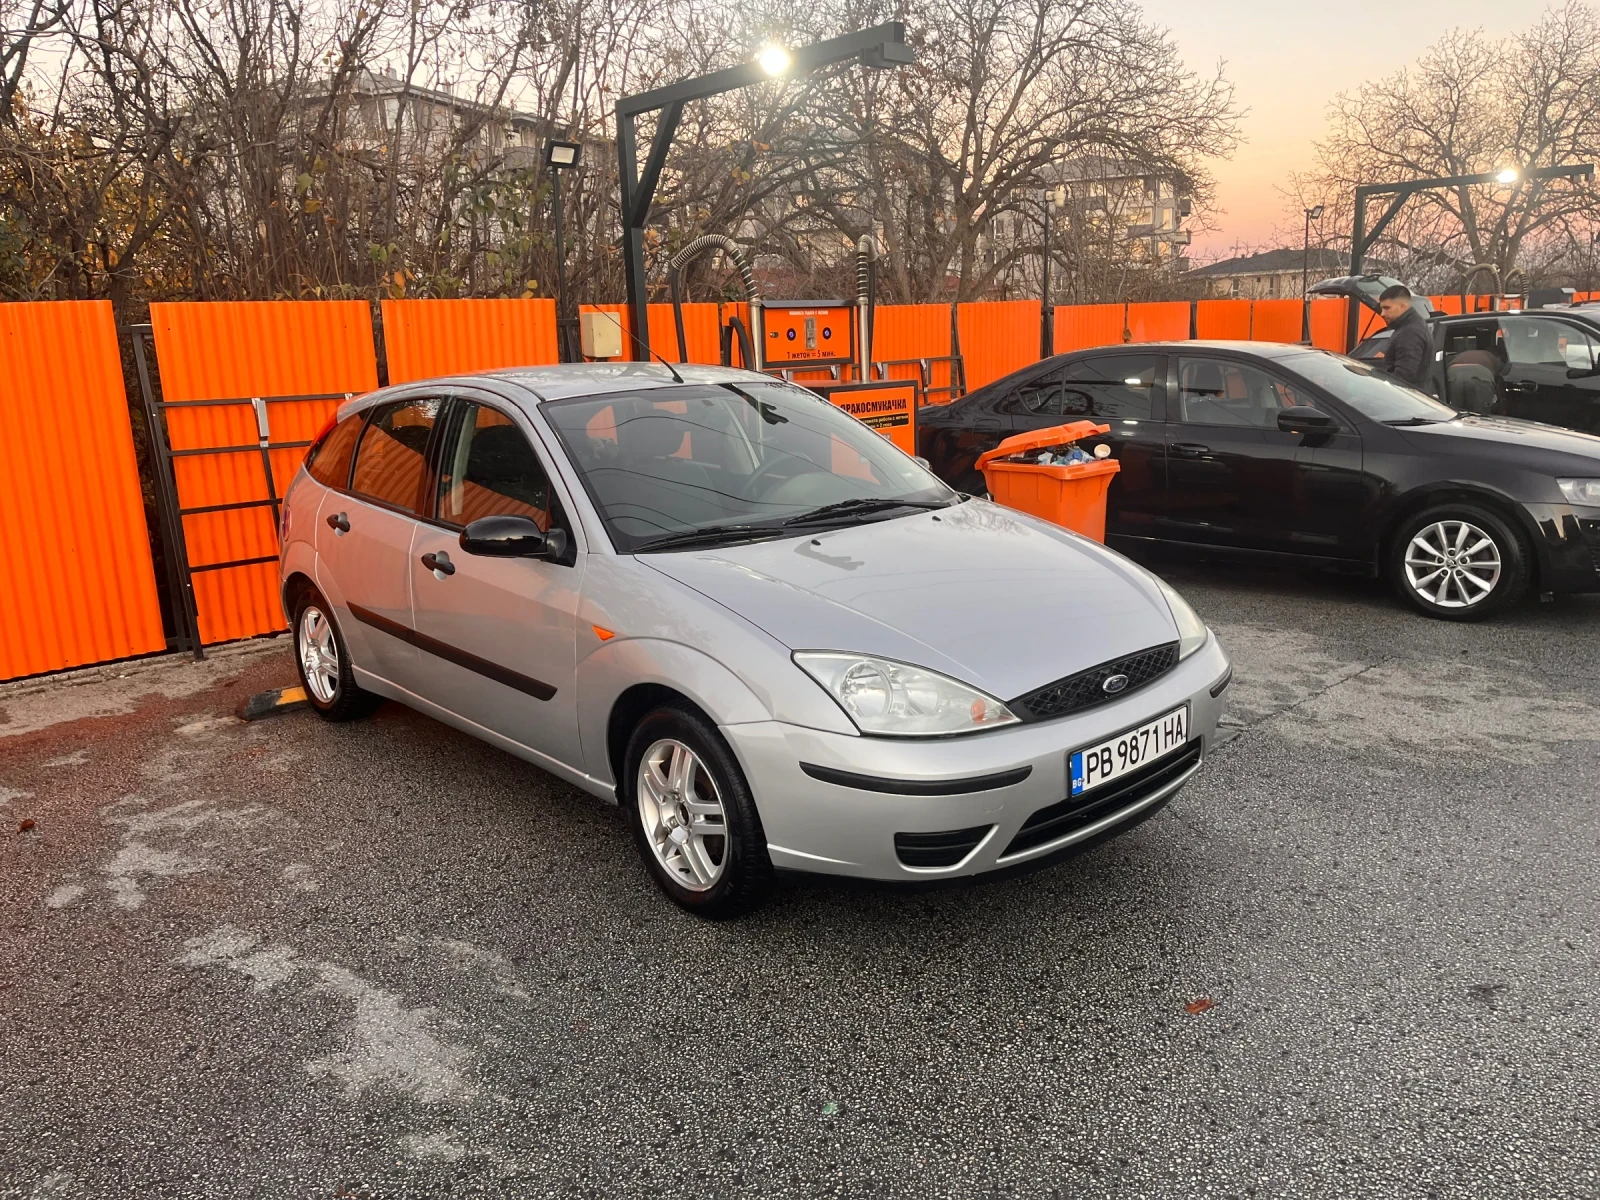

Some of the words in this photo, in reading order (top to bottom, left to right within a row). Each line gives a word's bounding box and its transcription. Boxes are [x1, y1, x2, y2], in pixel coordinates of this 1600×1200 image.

[1087, 747, 1113, 784] PB
[1117, 725, 1159, 770] 9871
[1164, 714, 1184, 749] HA
[1072, 778, 1082, 788] BG
